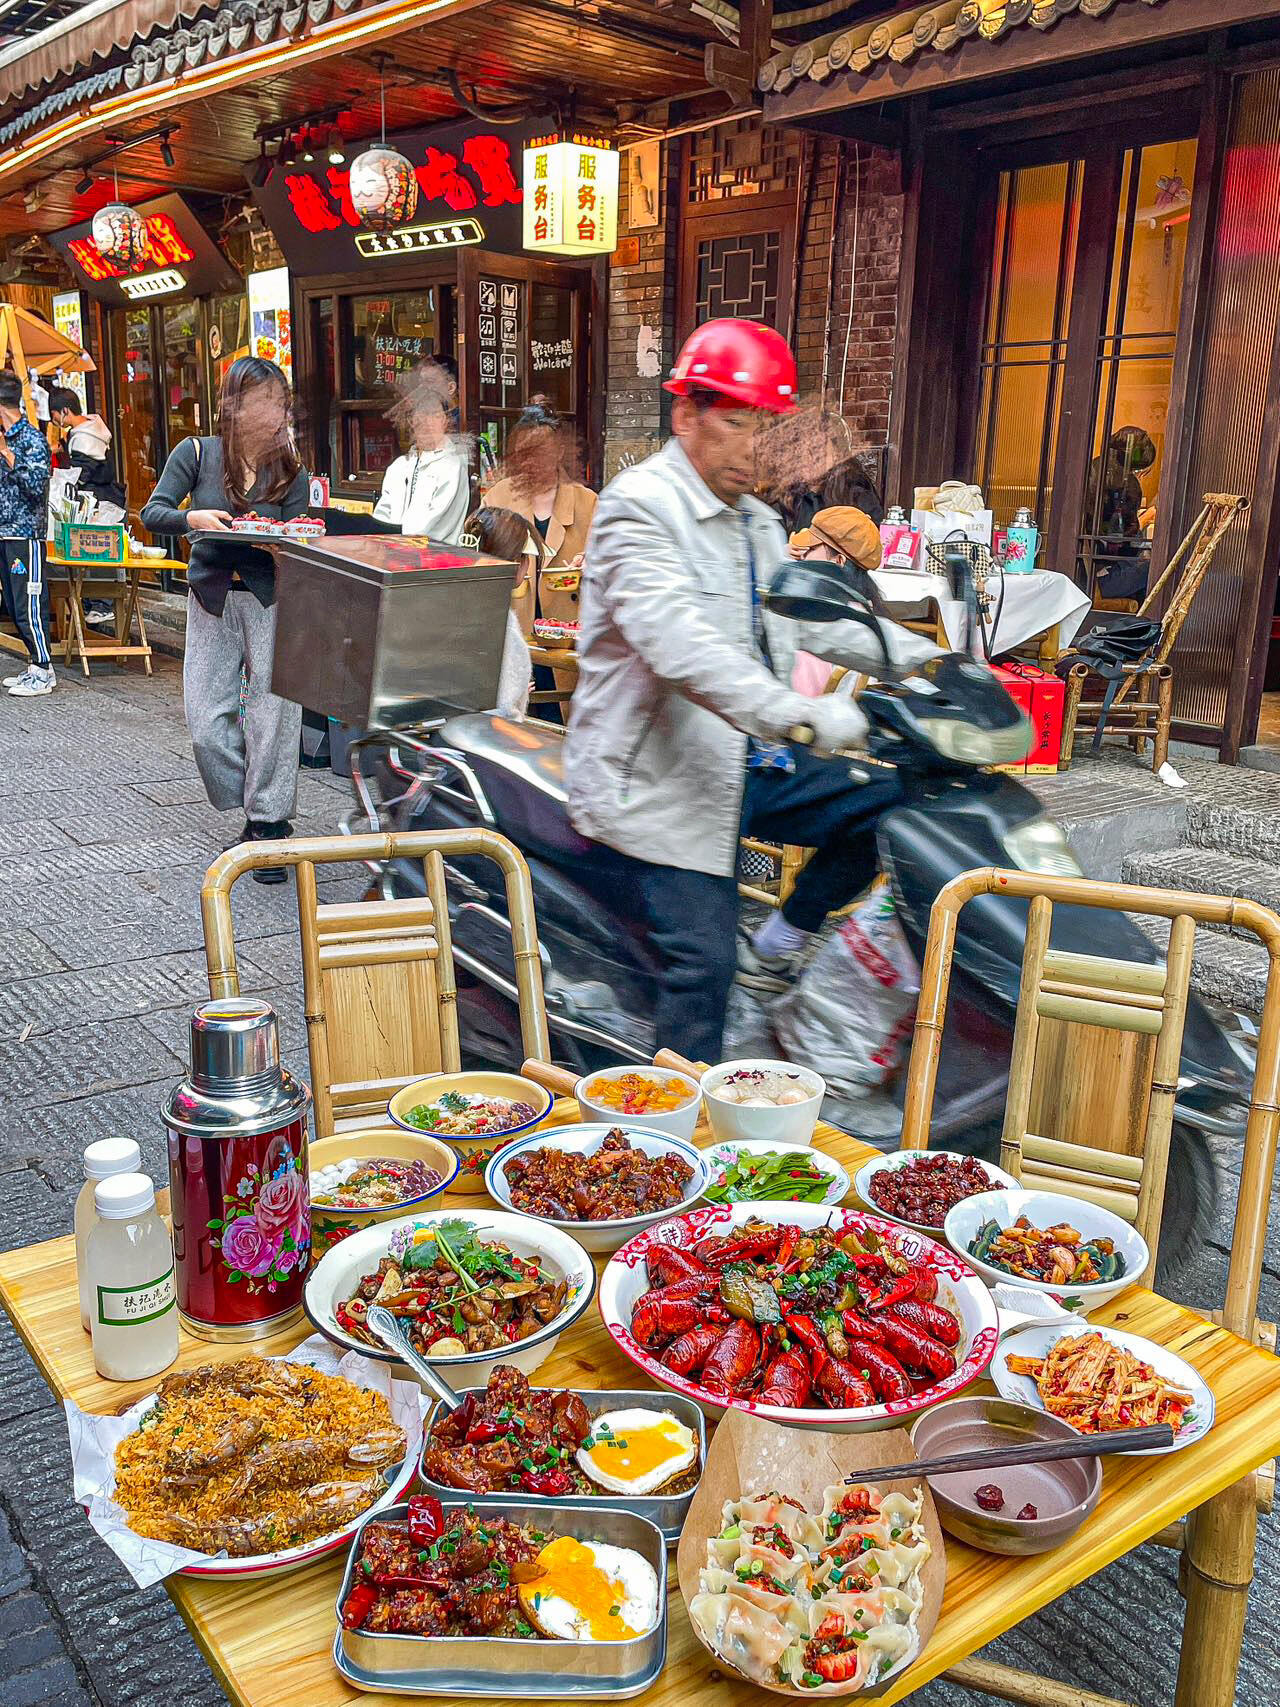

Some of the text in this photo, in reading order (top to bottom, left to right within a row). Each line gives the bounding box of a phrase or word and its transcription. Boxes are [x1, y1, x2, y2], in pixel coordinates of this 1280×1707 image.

[533, 153, 548, 241] 服务台
[577, 153, 596, 241] 服务台
[375, 336, 422, 355] 扶记小吃货
[661, 1226, 679, 1243] 祥
[900, 1239, 919, 1257] 如
